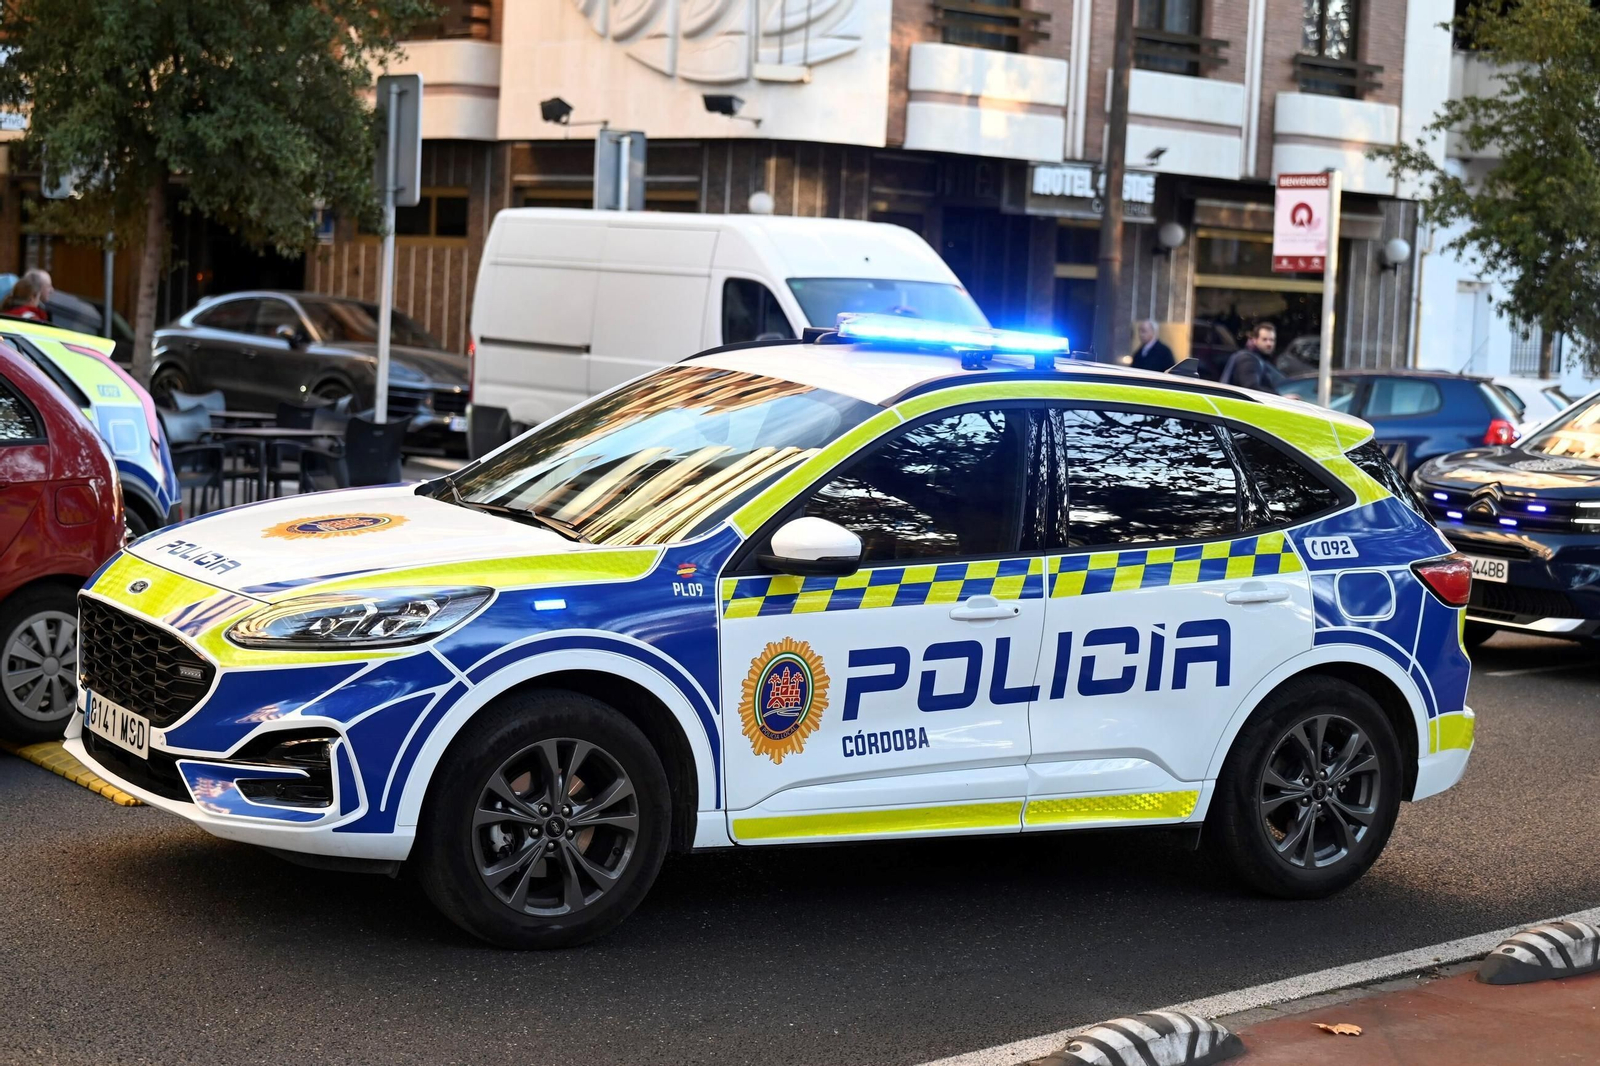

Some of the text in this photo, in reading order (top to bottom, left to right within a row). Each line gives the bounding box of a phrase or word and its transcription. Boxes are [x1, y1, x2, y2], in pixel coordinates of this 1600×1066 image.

[1033, 166, 1096, 198] HOTEL
[1321, 540, 1351, 556] 092
[672, 582, 703, 597] PL09
[90, 697, 145, 750] 8141 MSD
[842, 726, 930, 757] CÓRDOBA
